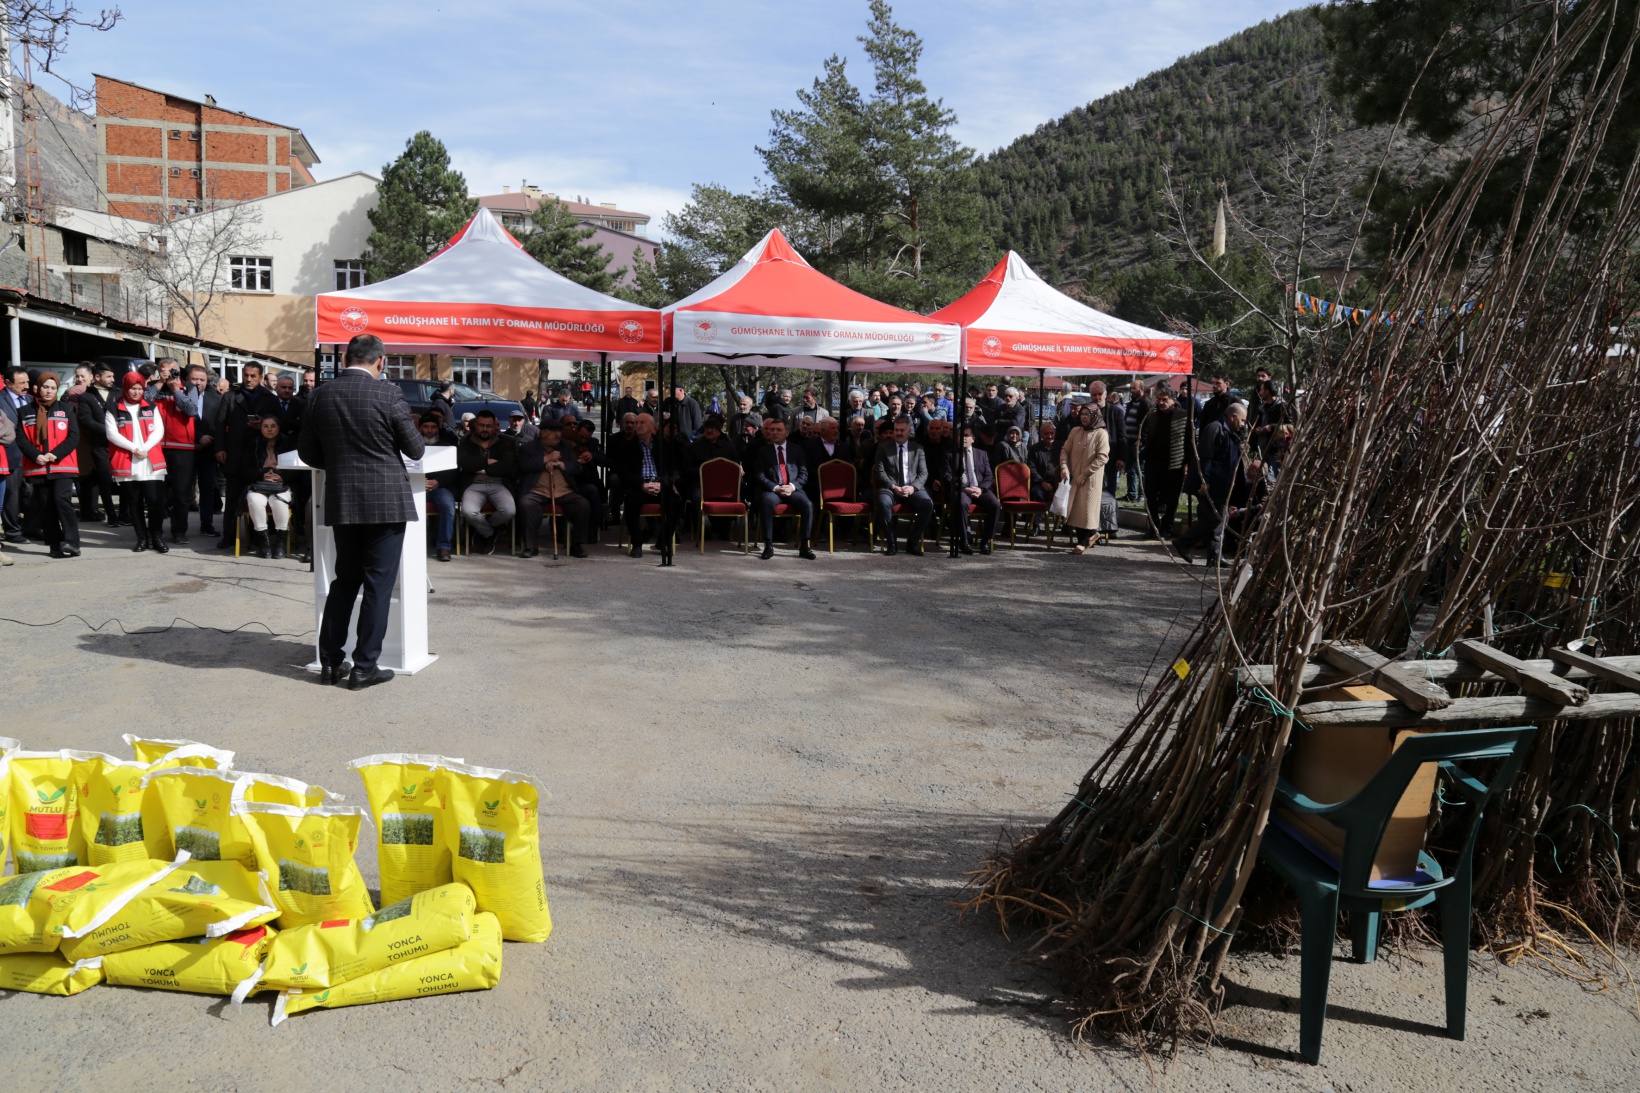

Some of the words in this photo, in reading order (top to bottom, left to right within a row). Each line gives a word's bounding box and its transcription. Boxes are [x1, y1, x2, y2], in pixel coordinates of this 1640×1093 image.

[384, 314, 449, 327] GÜMÜŞHANE
[450, 316, 459, 326] İL
[460, 317, 491, 326] TARIM
[492, 318, 505, 327] VE
[506, 319, 542, 329] ORMAN
[544, 321, 605, 333] MÜDÜRLÜĞÜ
[730, 325, 785, 337] GÜMÜŞHANE
[787, 327, 794, 337] İL
[795, 329, 821, 337] TARIM
[821, 330, 832, 338] VE
[833, 330, 863, 340] ORMAN
[864, 331, 915, 343] MÜDÜRLÜĞÜ
[1012, 342, 1055, 353] GÜMÜŞHANE
[1056, 345, 1062, 353] İL
[1063, 345, 1082, 353] TARIM
[1083, 346, 1091, 354] VE
[1092, 346, 1116, 355] ORMAN
[30, 805, 63, 813] MUTLU
[20, 841, 38, 850] YONCA
[91, 921, 131, 940] TOHUMU
[99, 933, 132, 947] YONCA
[387, 934, 423, 951] YONCA
[387, 943, 429, 962] TOHUMU
[144, 967, 176, 977] YONCA
[419, 972, 455, 985] YONCA
[141, 978, 181, 987] TOHUMU
[416, 982, 460, 994] TOHUMU
